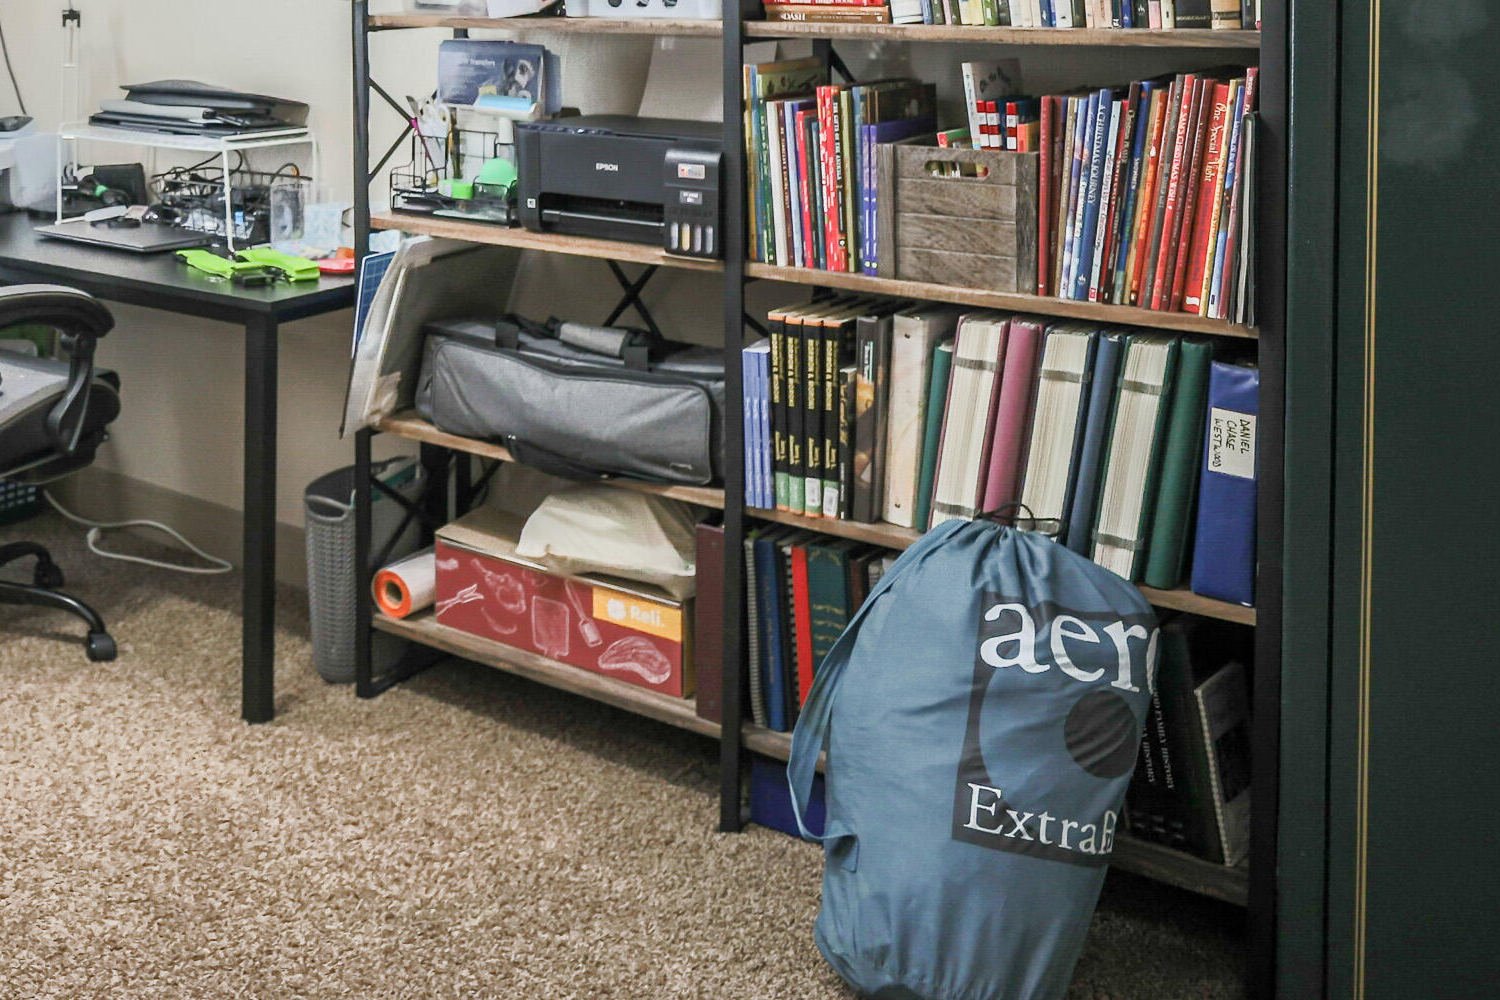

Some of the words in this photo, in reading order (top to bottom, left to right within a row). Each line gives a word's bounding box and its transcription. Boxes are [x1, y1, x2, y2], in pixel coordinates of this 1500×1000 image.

[1177, 112, 1186, 135] SAM'S
[1212, 102, 1226, 121] One
[1092, 110, 1106, 162] CHRISTMAS
[1206, 123, 1223, 154] Special
[595, 162, 619, 172] EPSON
[1130, 157, 1139, 189] SNOWMEN
[1170, 135, 1183, 180] CHRISTMAS
[1088, 164, 1101, 204] JOURNEY
[1167, 181, 1177, 201] WISH
[1212, 418, 1224, 467] WESTWOOD
[1226, 420, 1238, 451] CHASE
[1240, 419, 1251, 454] DANIEL
[980, 602, 1161, 695] aer
[1143, 741, 1156, 783] HISTORY
[1154, 710, 1167, 743] FAMILY
[1161, 747, 1175, 789] HISTORY
